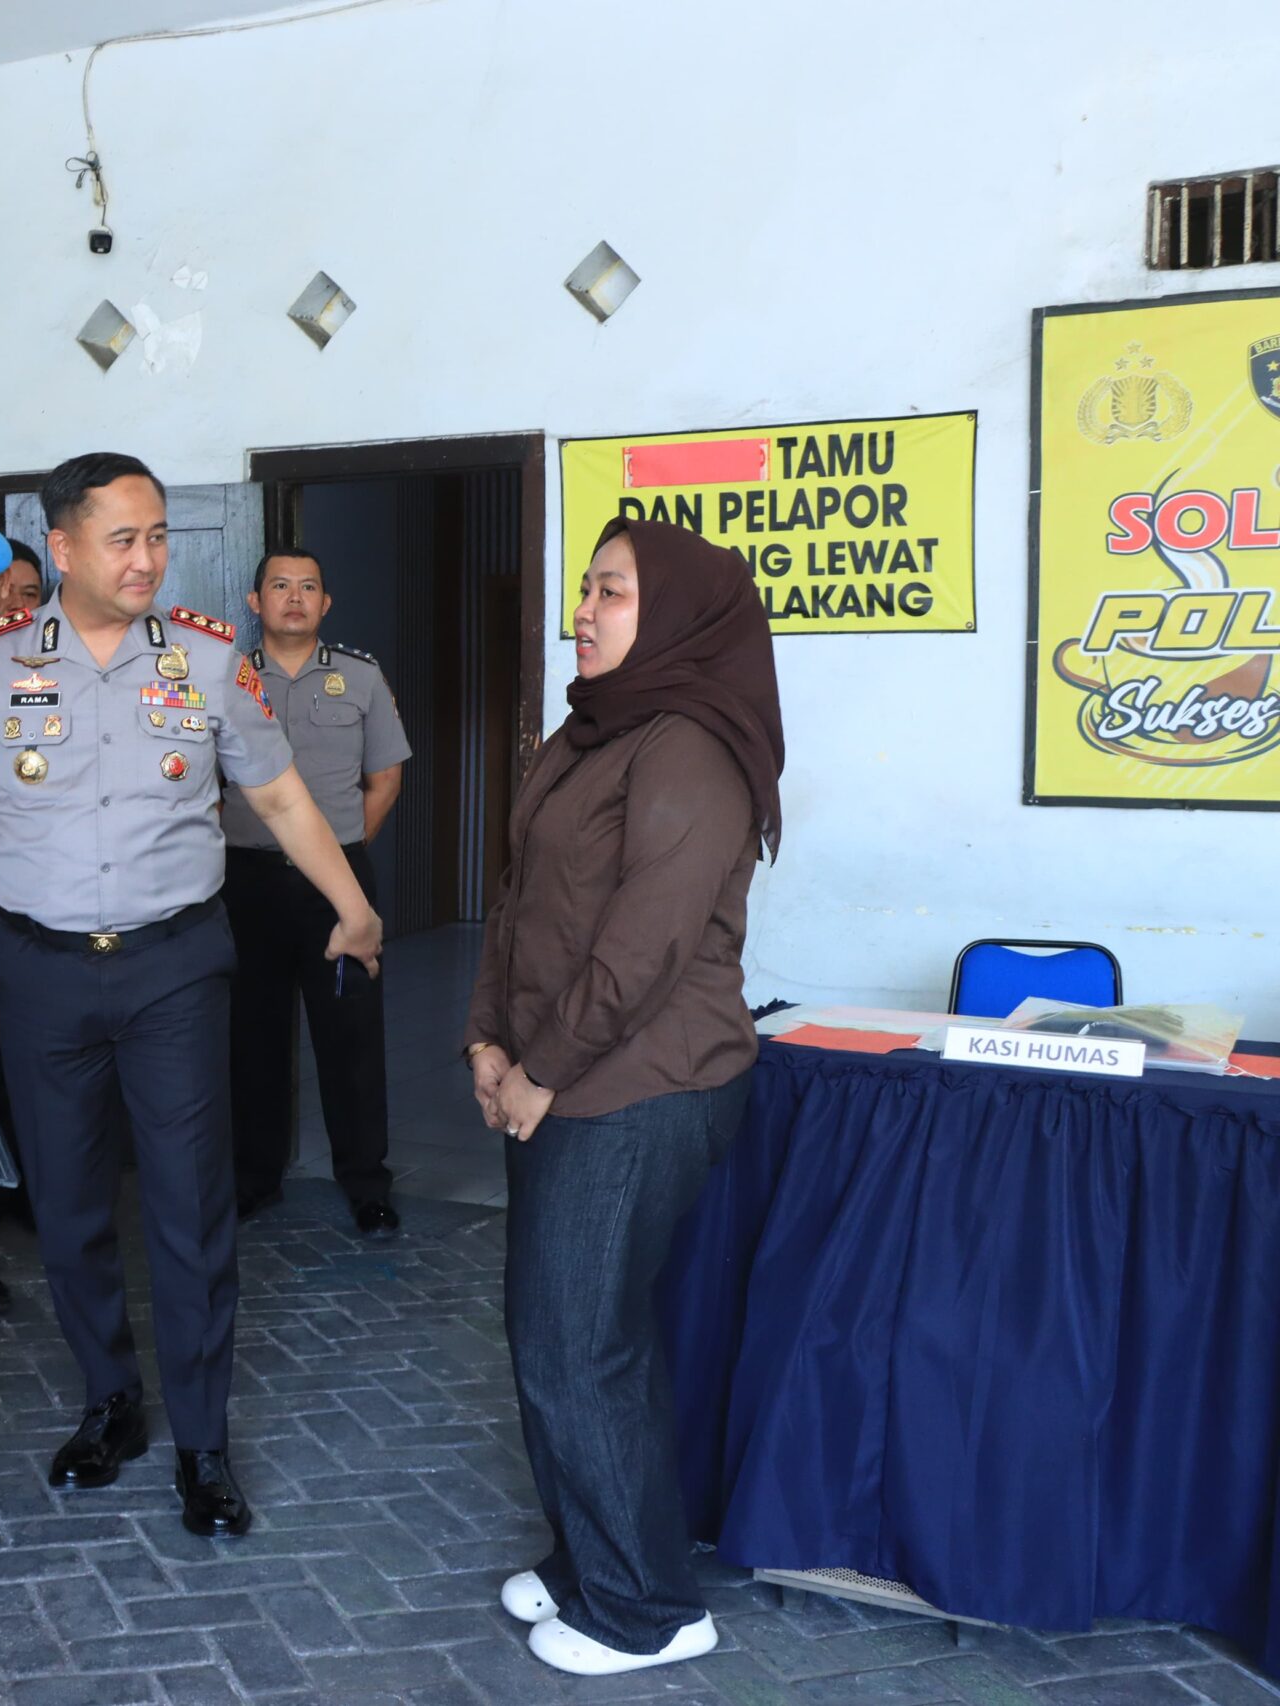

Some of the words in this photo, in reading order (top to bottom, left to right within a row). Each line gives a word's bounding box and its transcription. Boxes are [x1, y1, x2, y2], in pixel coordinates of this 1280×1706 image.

[1255, 337, 1280, 354] BAR
[777, 431, 894, 479] TAMU
[719, 483, 908, 534] PELAPOR
[807, 538, 938, 576] LEWAT
[756, 582, 933, 619] LAKANG
[20, 696, 49, 704] RAMA
[1097, 677, 1280, 738] Sukses
[969, 1037, 1020, 1057] KASI
[1027, 1043, 1119, 1066] HUMAS
